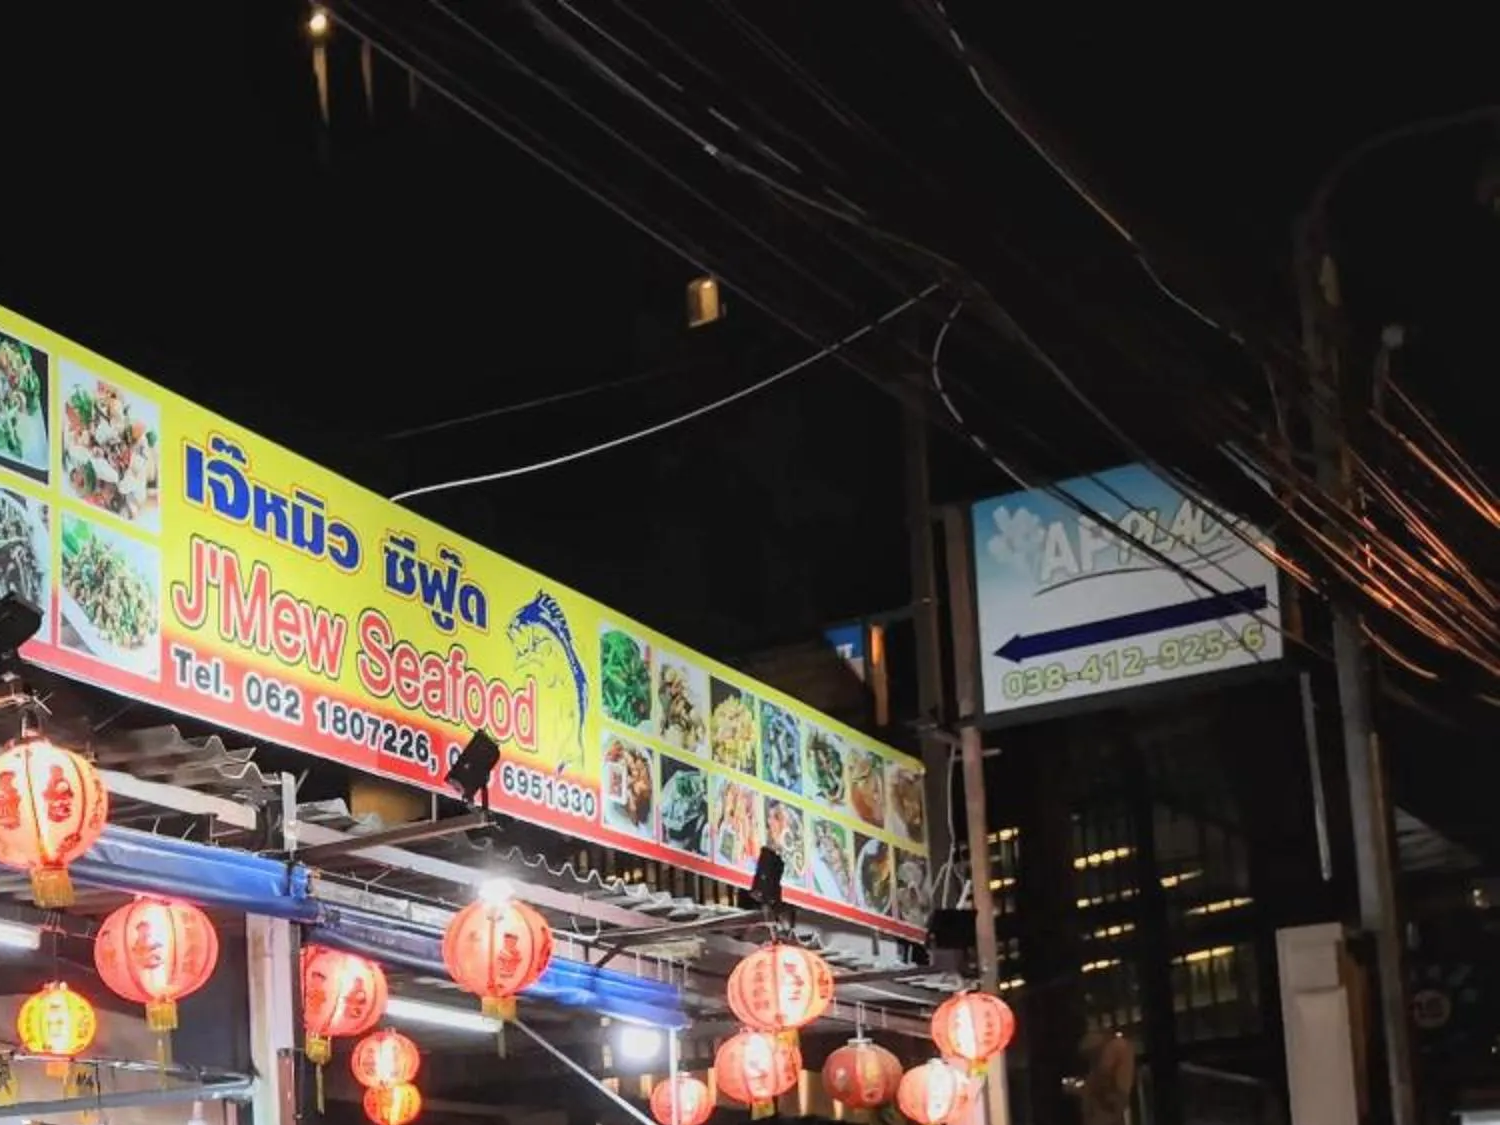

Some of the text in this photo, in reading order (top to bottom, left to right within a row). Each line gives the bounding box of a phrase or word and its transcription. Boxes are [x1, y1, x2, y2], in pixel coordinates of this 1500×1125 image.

[173, 538, 538, 749] J'Mew Seafood
[1003, 621, 1265, 699] 038-412-925-6
[173, 646, 231, 698] Tel.
[245, 674, 301, 721] 062
[315, 699, 437, 773] 1807226,
[503, 764, 595, 817] 6951330
